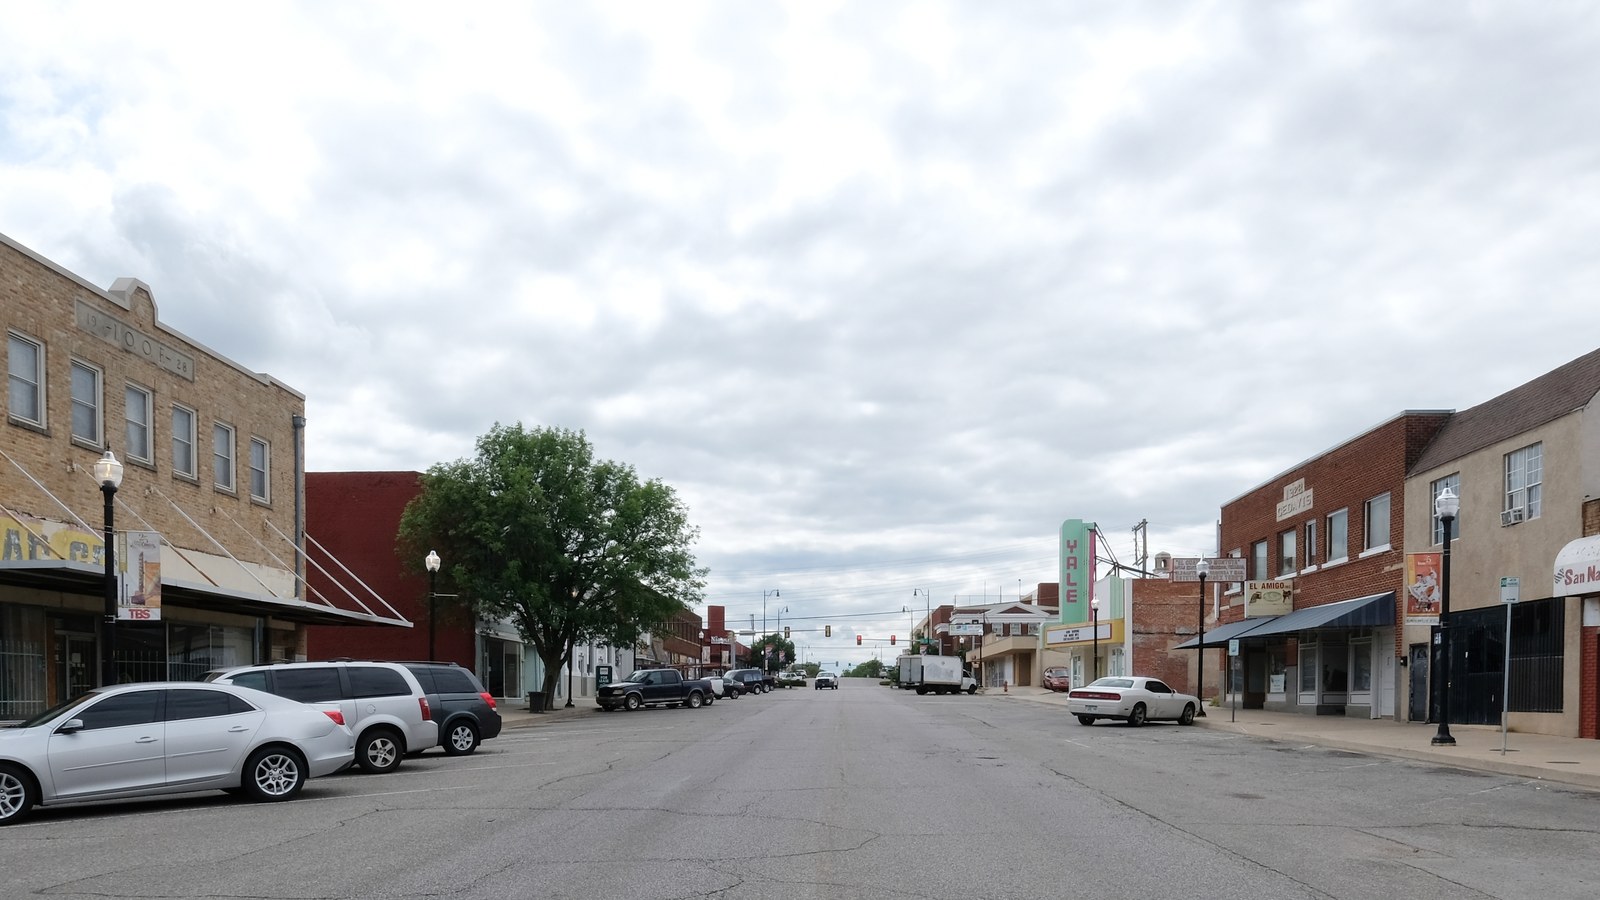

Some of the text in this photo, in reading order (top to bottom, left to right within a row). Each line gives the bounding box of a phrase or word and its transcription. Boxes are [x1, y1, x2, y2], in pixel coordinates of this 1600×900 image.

[1066, 539, 1078, 603] YALE
[1564, 568, 1585, 586] San
[1249, 582, 1258, 590] EL
[1261, 582, 1285, 590] AMIGO
[128, 608, 151, 619] TBS
